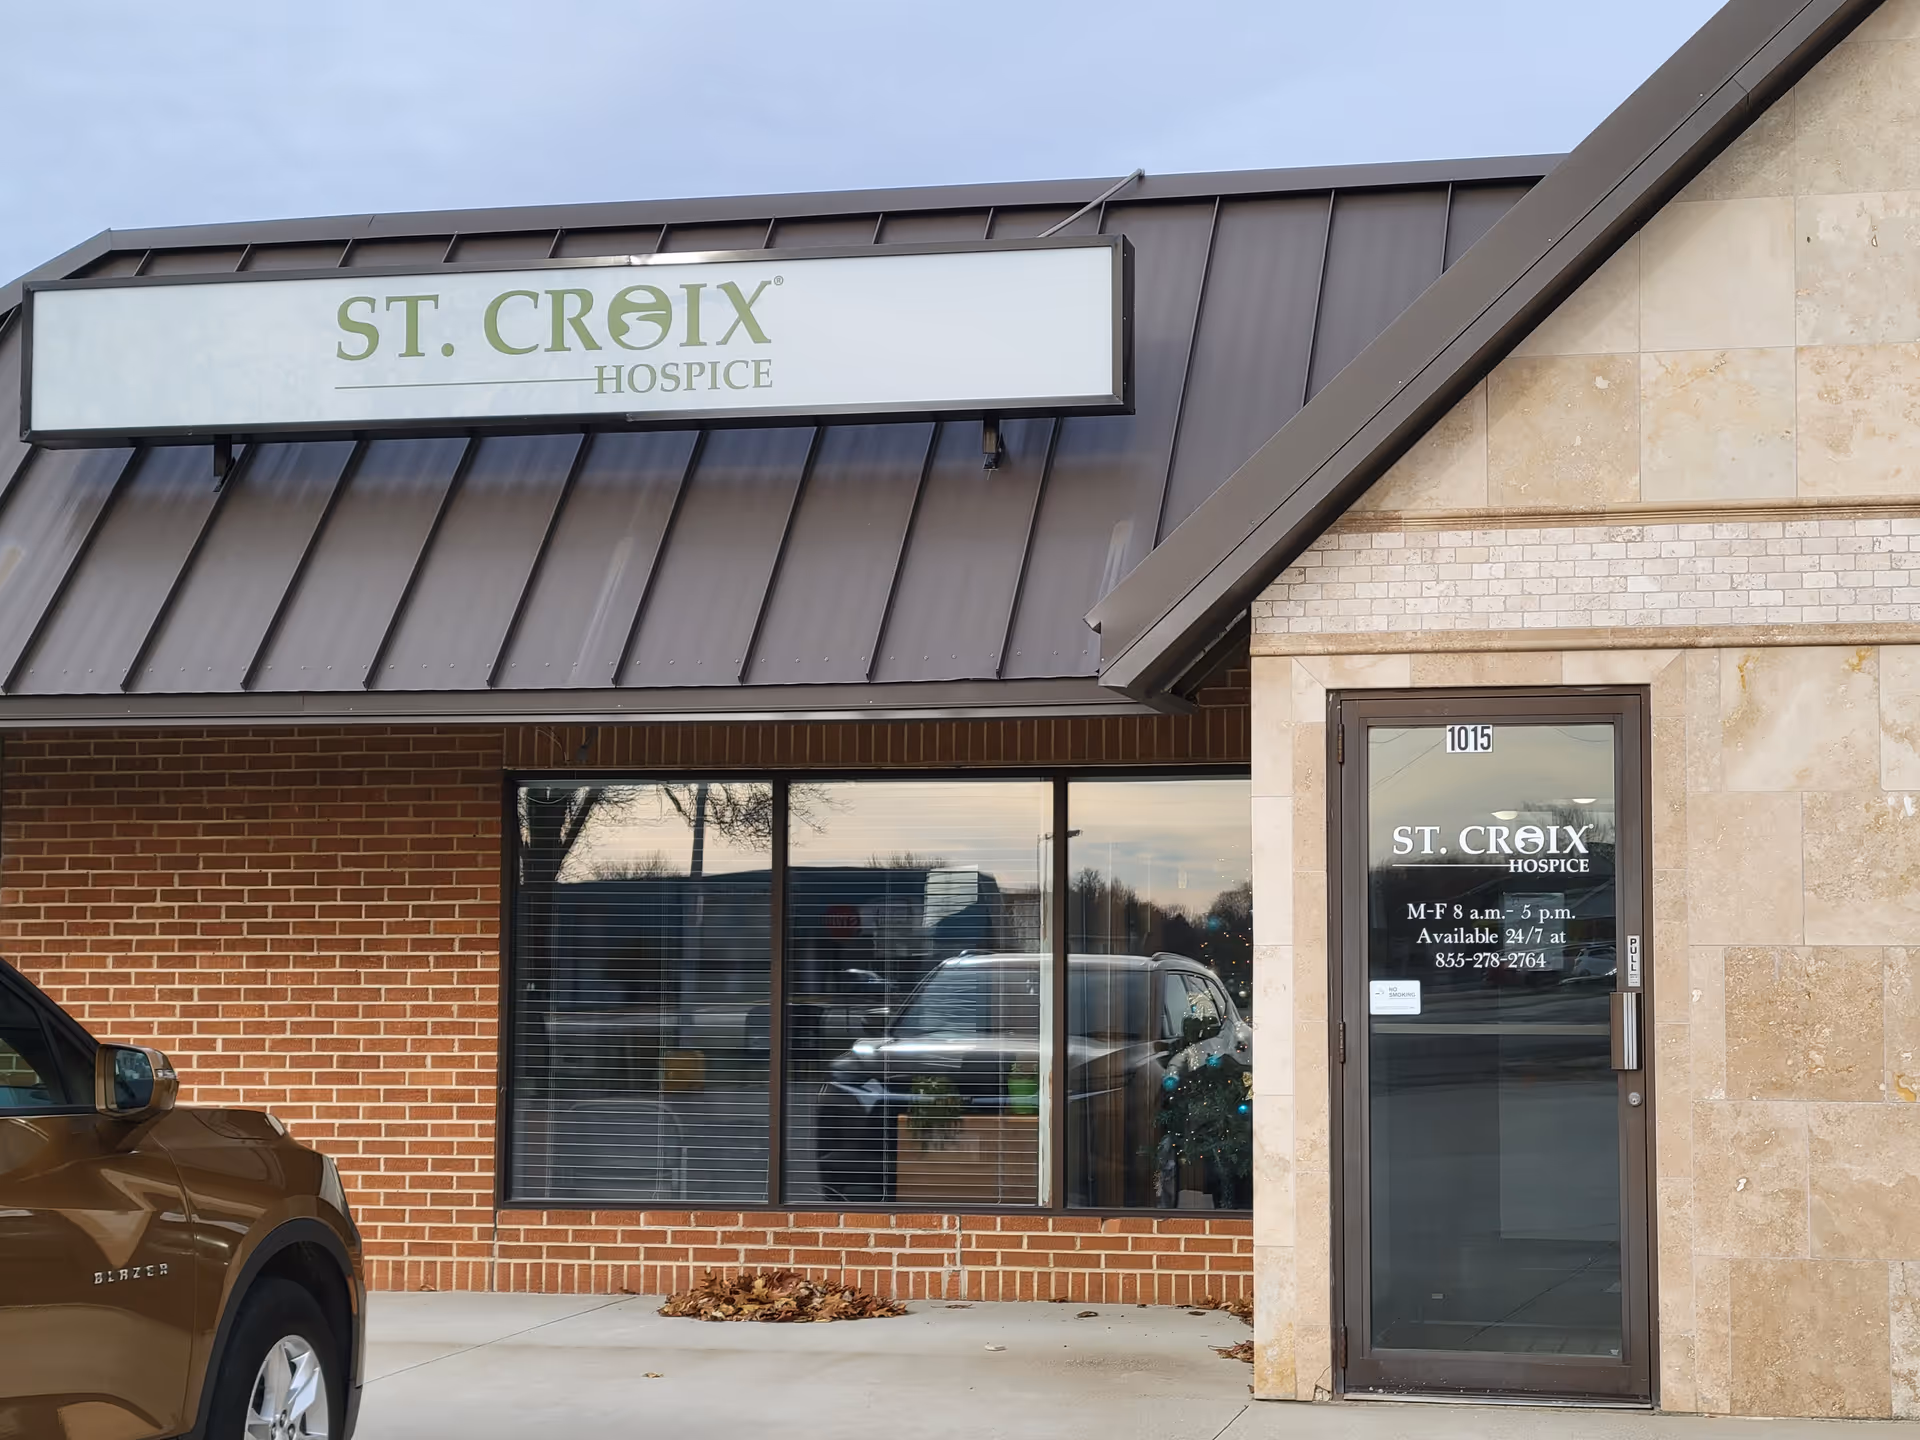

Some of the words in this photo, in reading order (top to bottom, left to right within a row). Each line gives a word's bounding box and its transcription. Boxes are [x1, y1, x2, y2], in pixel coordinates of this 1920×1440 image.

[336, 294, 454, 361] ST.
[594, 358, 773, 394] HOSPICE
[1448, 725, 1491, 751] 1015
[1392, 825, 1447, 855] ST.
[1509, 858, 1590, 873] HOSPICE
[1407, 903, 1447, 920] M-F
[1453, 904, 1463, 919] 8
[1521, 904, 1532, 919] 5
[1539, 908, 1576, 924] p.m.
[1416, 927, 1499, 944] Available
[1505, 926, 1544, 944] 24/7
[1550, 930, 1567, 944] at
[1435, 952, 1547, 968] 855-278-2764
[94, 1263, 168, 1284] BLAZER
